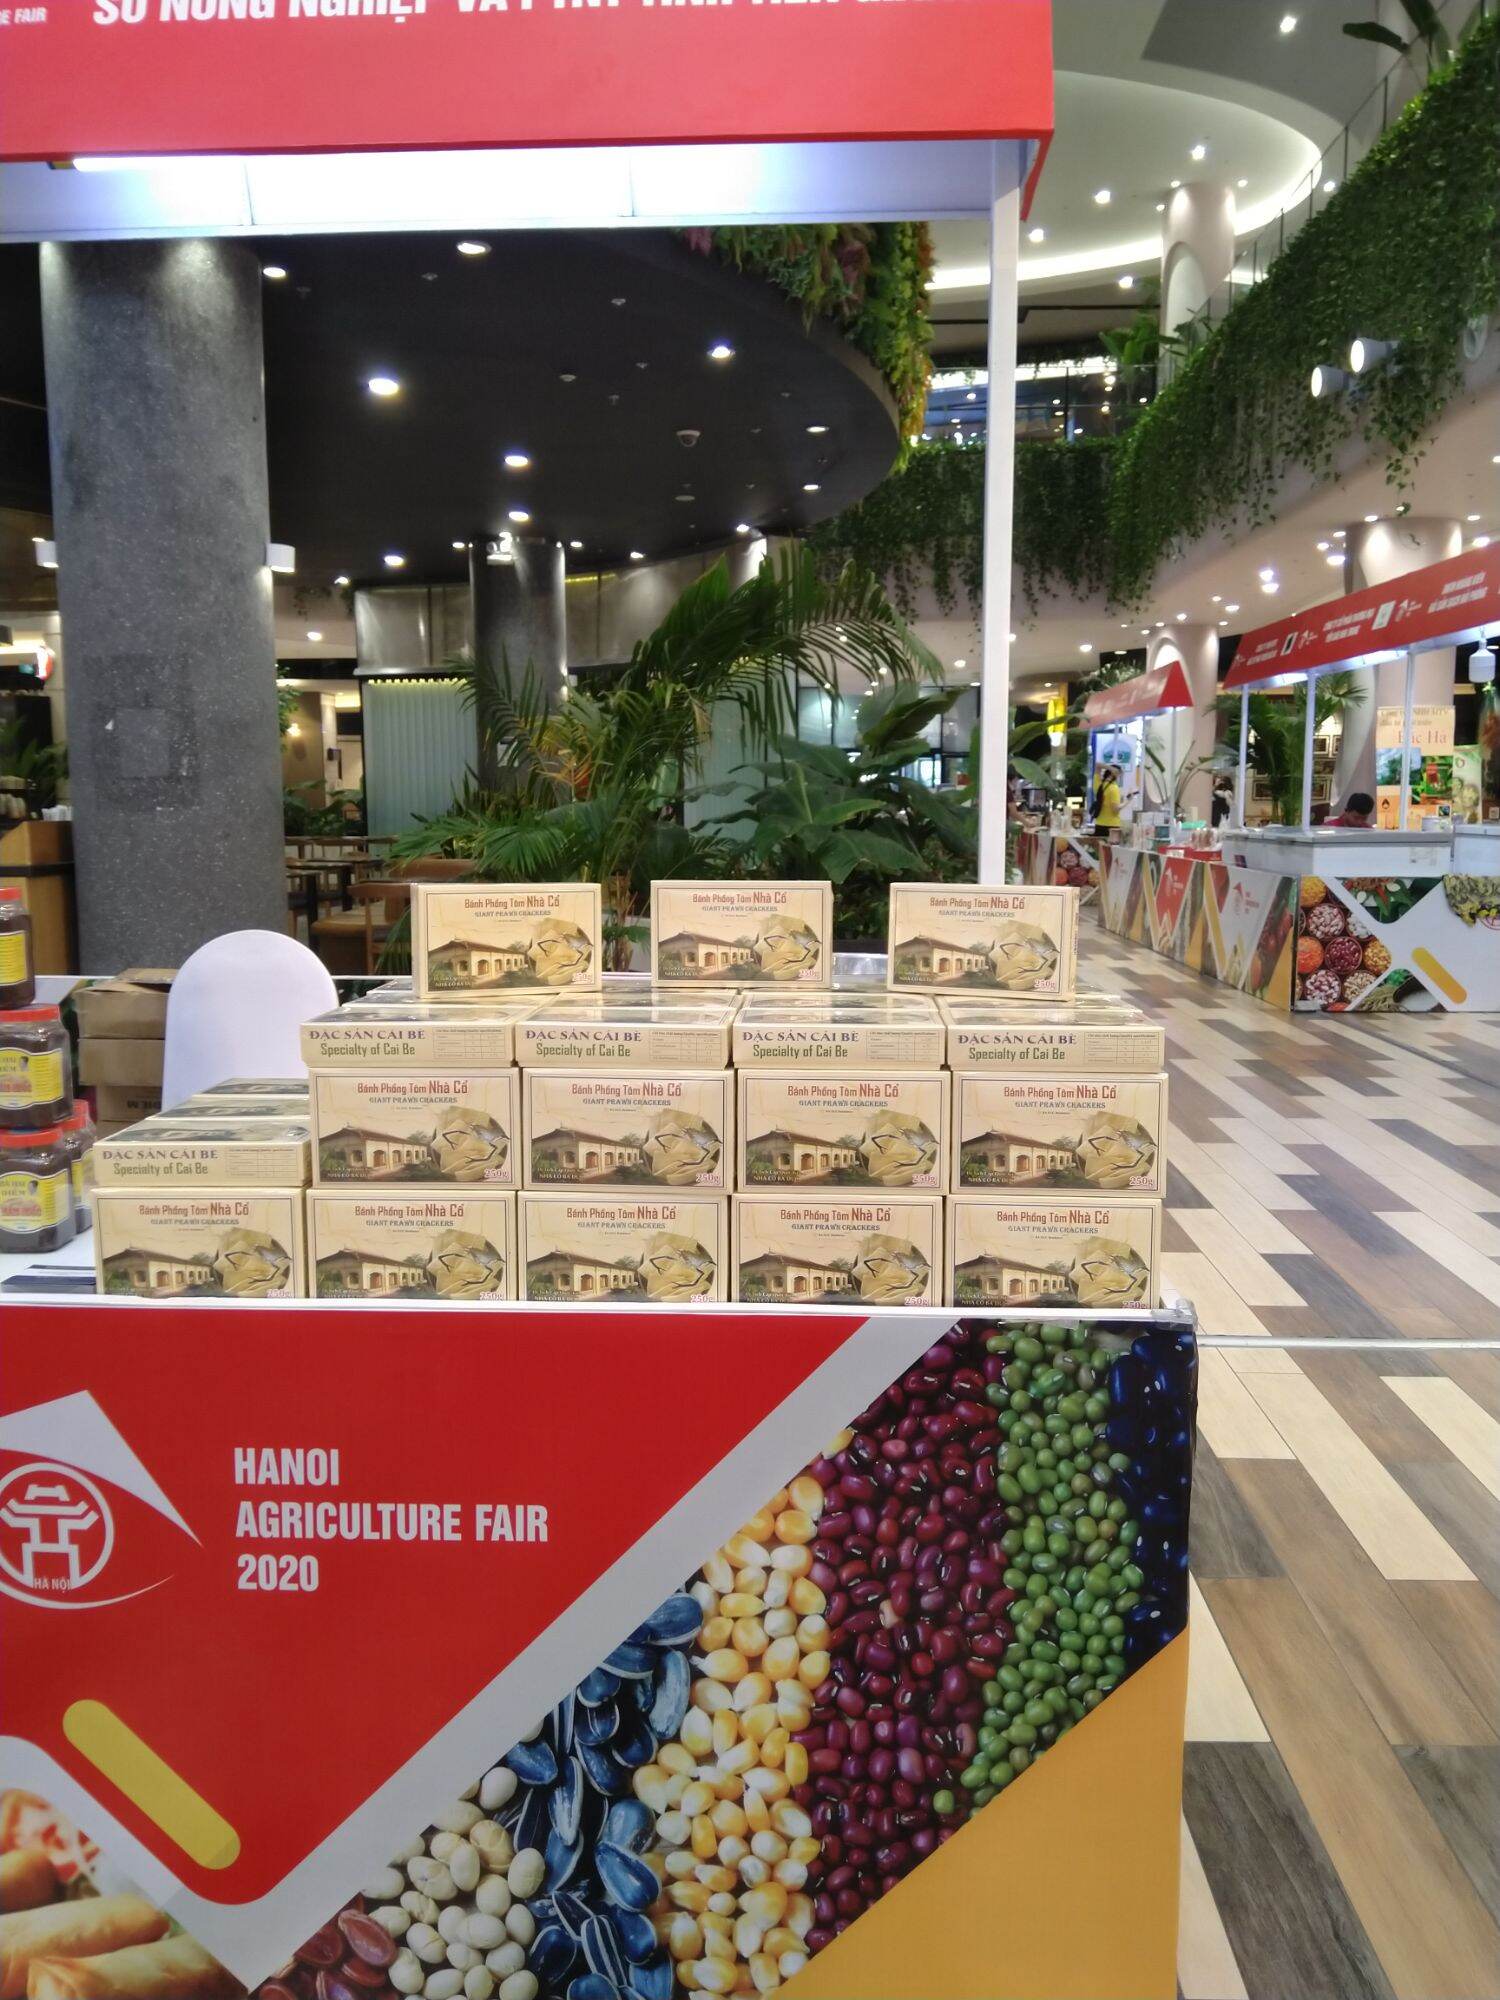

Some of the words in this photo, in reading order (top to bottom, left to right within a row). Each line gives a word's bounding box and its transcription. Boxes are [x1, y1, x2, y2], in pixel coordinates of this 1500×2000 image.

[15, 8, 46, 23] FAIR
[321, 1043, 367, 1057] Specialty
[370, 1044, 380, 1055] of
[384, 1043, 400, 1055] Cai
[403, 1043, 415, 1055] Be
[536, 1043, 582, 1057] Specialty
[586, 1045, 596, 1056] of
[600, 1044, 615, 1056] Cai
[618, 1045, 630, 1057] Be
[754, 1044, 798, 1058] Specialty
[803, 1045, 813, 1057] of
[816, 1045, 832, 1057] Cai
[835, 1045, 848, 1057] Be
[969, 1047, 1015, 1061] Specialty
[1020, 1048, 1029, 1059] of
[1033, 1048, 1049, 1060] Cai
[1052, 1048, 1065, 1060] Be
[114, 1163, 160, 1177] Specialty
[164, 1164, 173, 1174] of
[176, 1163, 193, 1174] Cai
[196, 1164, 208, 1174] Be
[696, 1174, 721, 1184] 250g
[1129, 1177, 1154, 1186] 250g
[234, 1447, 339, 1486] HANOI
[235, 1501, 462, 1540] AGRICULTURE
[476, 1503, 548, 1542] FAIR
[238, 1554, 318, 1591] 2020
